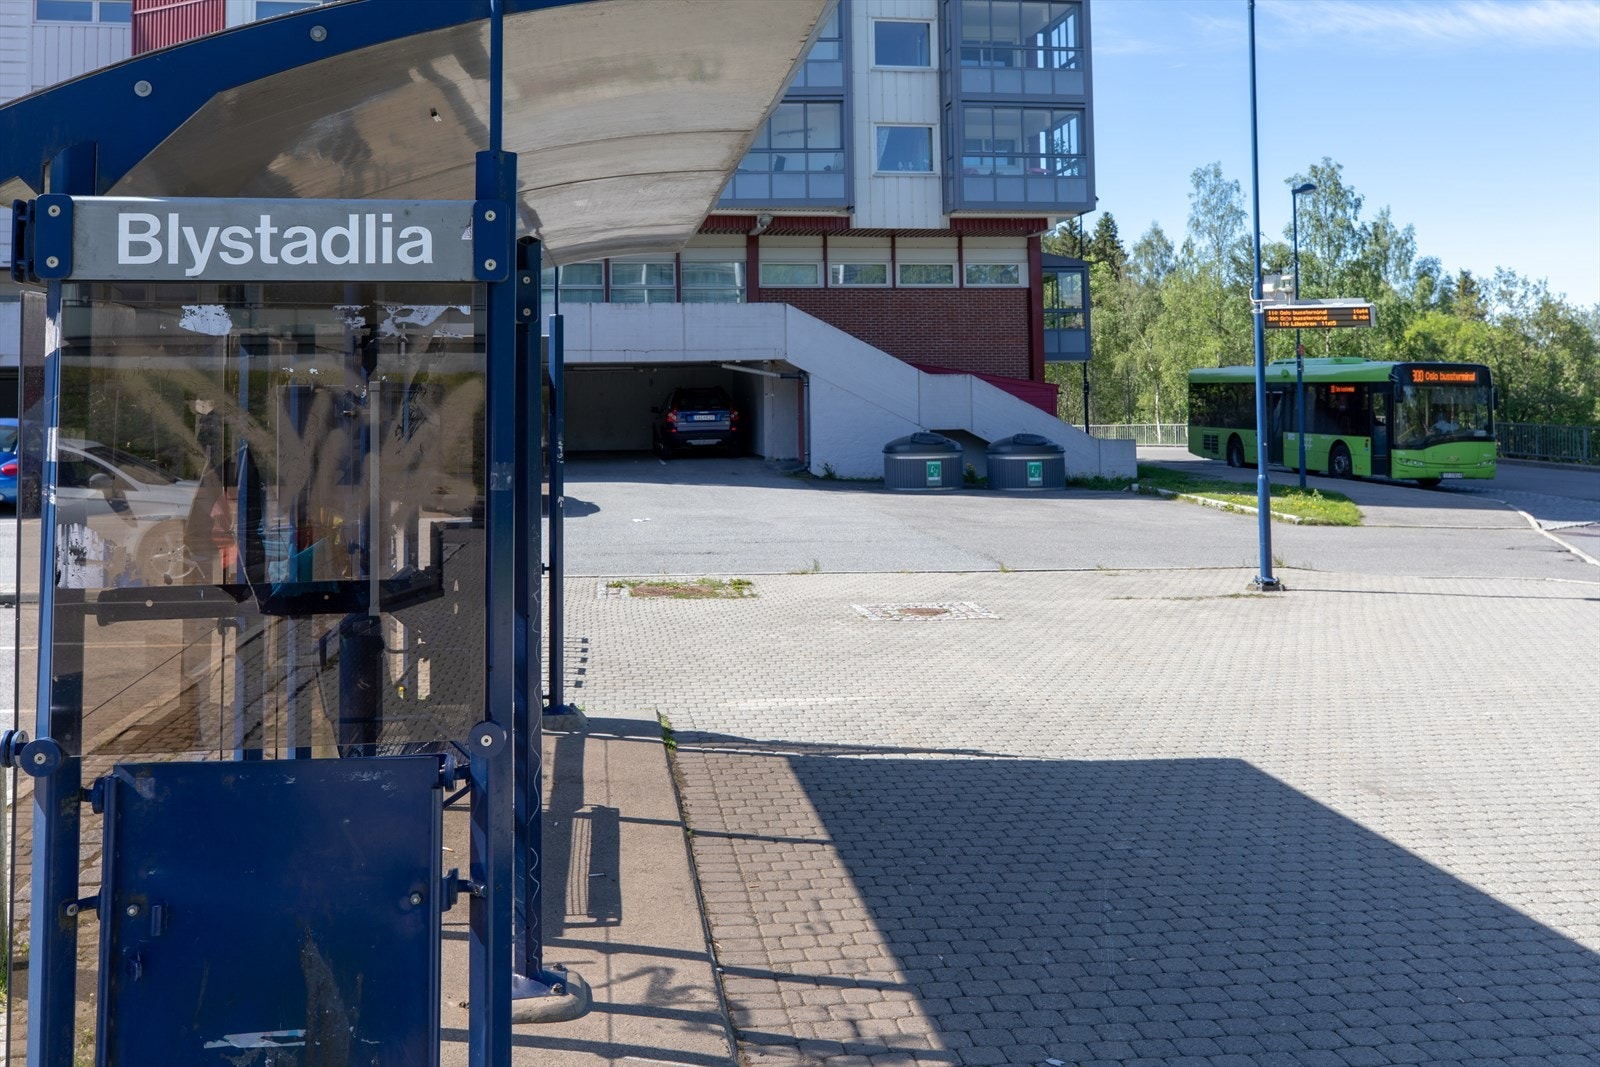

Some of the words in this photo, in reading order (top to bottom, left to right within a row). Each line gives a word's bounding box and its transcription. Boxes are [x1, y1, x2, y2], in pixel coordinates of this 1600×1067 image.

[118, 213, 433, 277] Blystadlia
[1412, 369, 1424, 382] 300
[1425, 371, 1439, 381] Oslo
[1440, 371, 1476, 381] bussterminal
